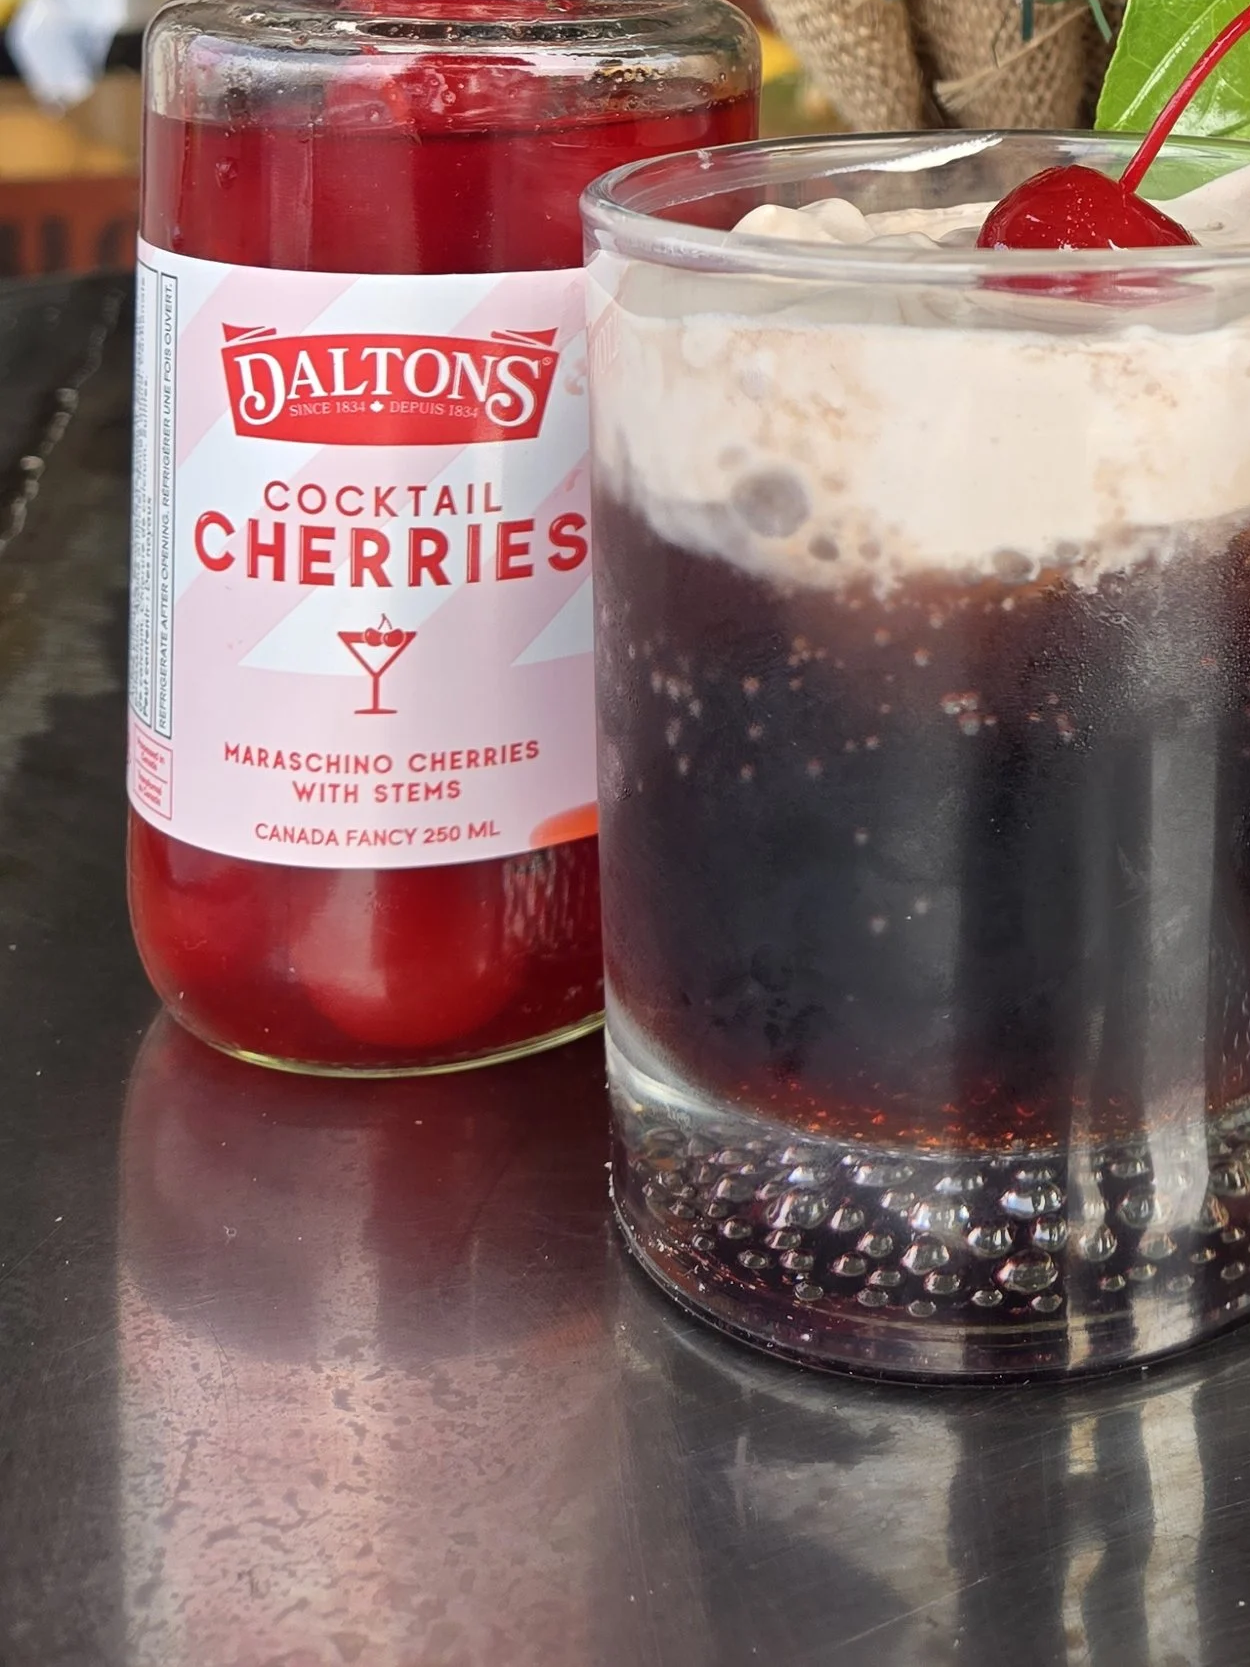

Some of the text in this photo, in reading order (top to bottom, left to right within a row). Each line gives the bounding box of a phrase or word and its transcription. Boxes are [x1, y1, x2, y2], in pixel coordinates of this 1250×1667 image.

[163, 283, 173, 346] OUVERT.
[163, 349, 172, 382] FOIS
[163, 388, 172, 415] UNE
[233, 347, 541, 427] DALTONS
[289, 401, 480, 419] SINCE 1834 DEPUIS 1834
[264, 480, 503, 517] COCKTAIL
[160, 510, 170, 581] OPENING.
[194, 510, 589, 588] CHERRIES
[159, 584, 169, 631] AFTER
[158, 633, 168, 729] REFRIGERATE
[224, 739, 540, 775] MARASCHINO CHERRIES
[292, 779, 461, 804] WITH STEMS
[255, 819, 501, 847] CANADA FANCY 250 ML
